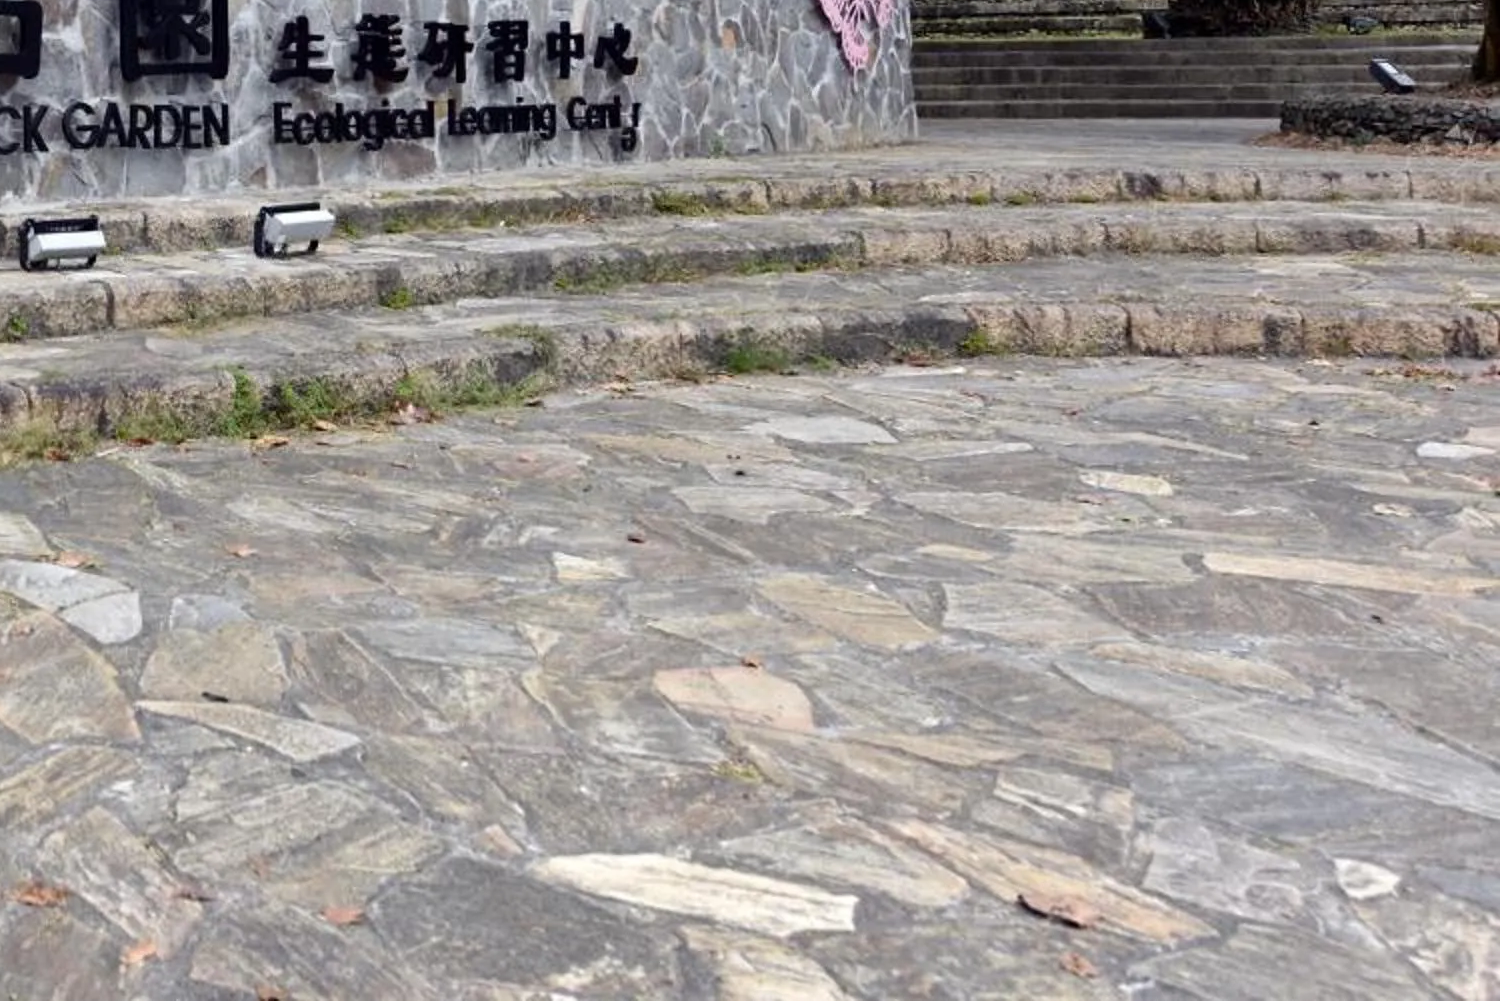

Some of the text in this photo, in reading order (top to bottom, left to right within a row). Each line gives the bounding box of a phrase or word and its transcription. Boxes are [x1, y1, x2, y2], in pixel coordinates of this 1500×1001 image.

[62, 102, 230, 149] GARDEN
[273, 98, 435, 151] Ecological
[448, 96, 556, 140] Learning
